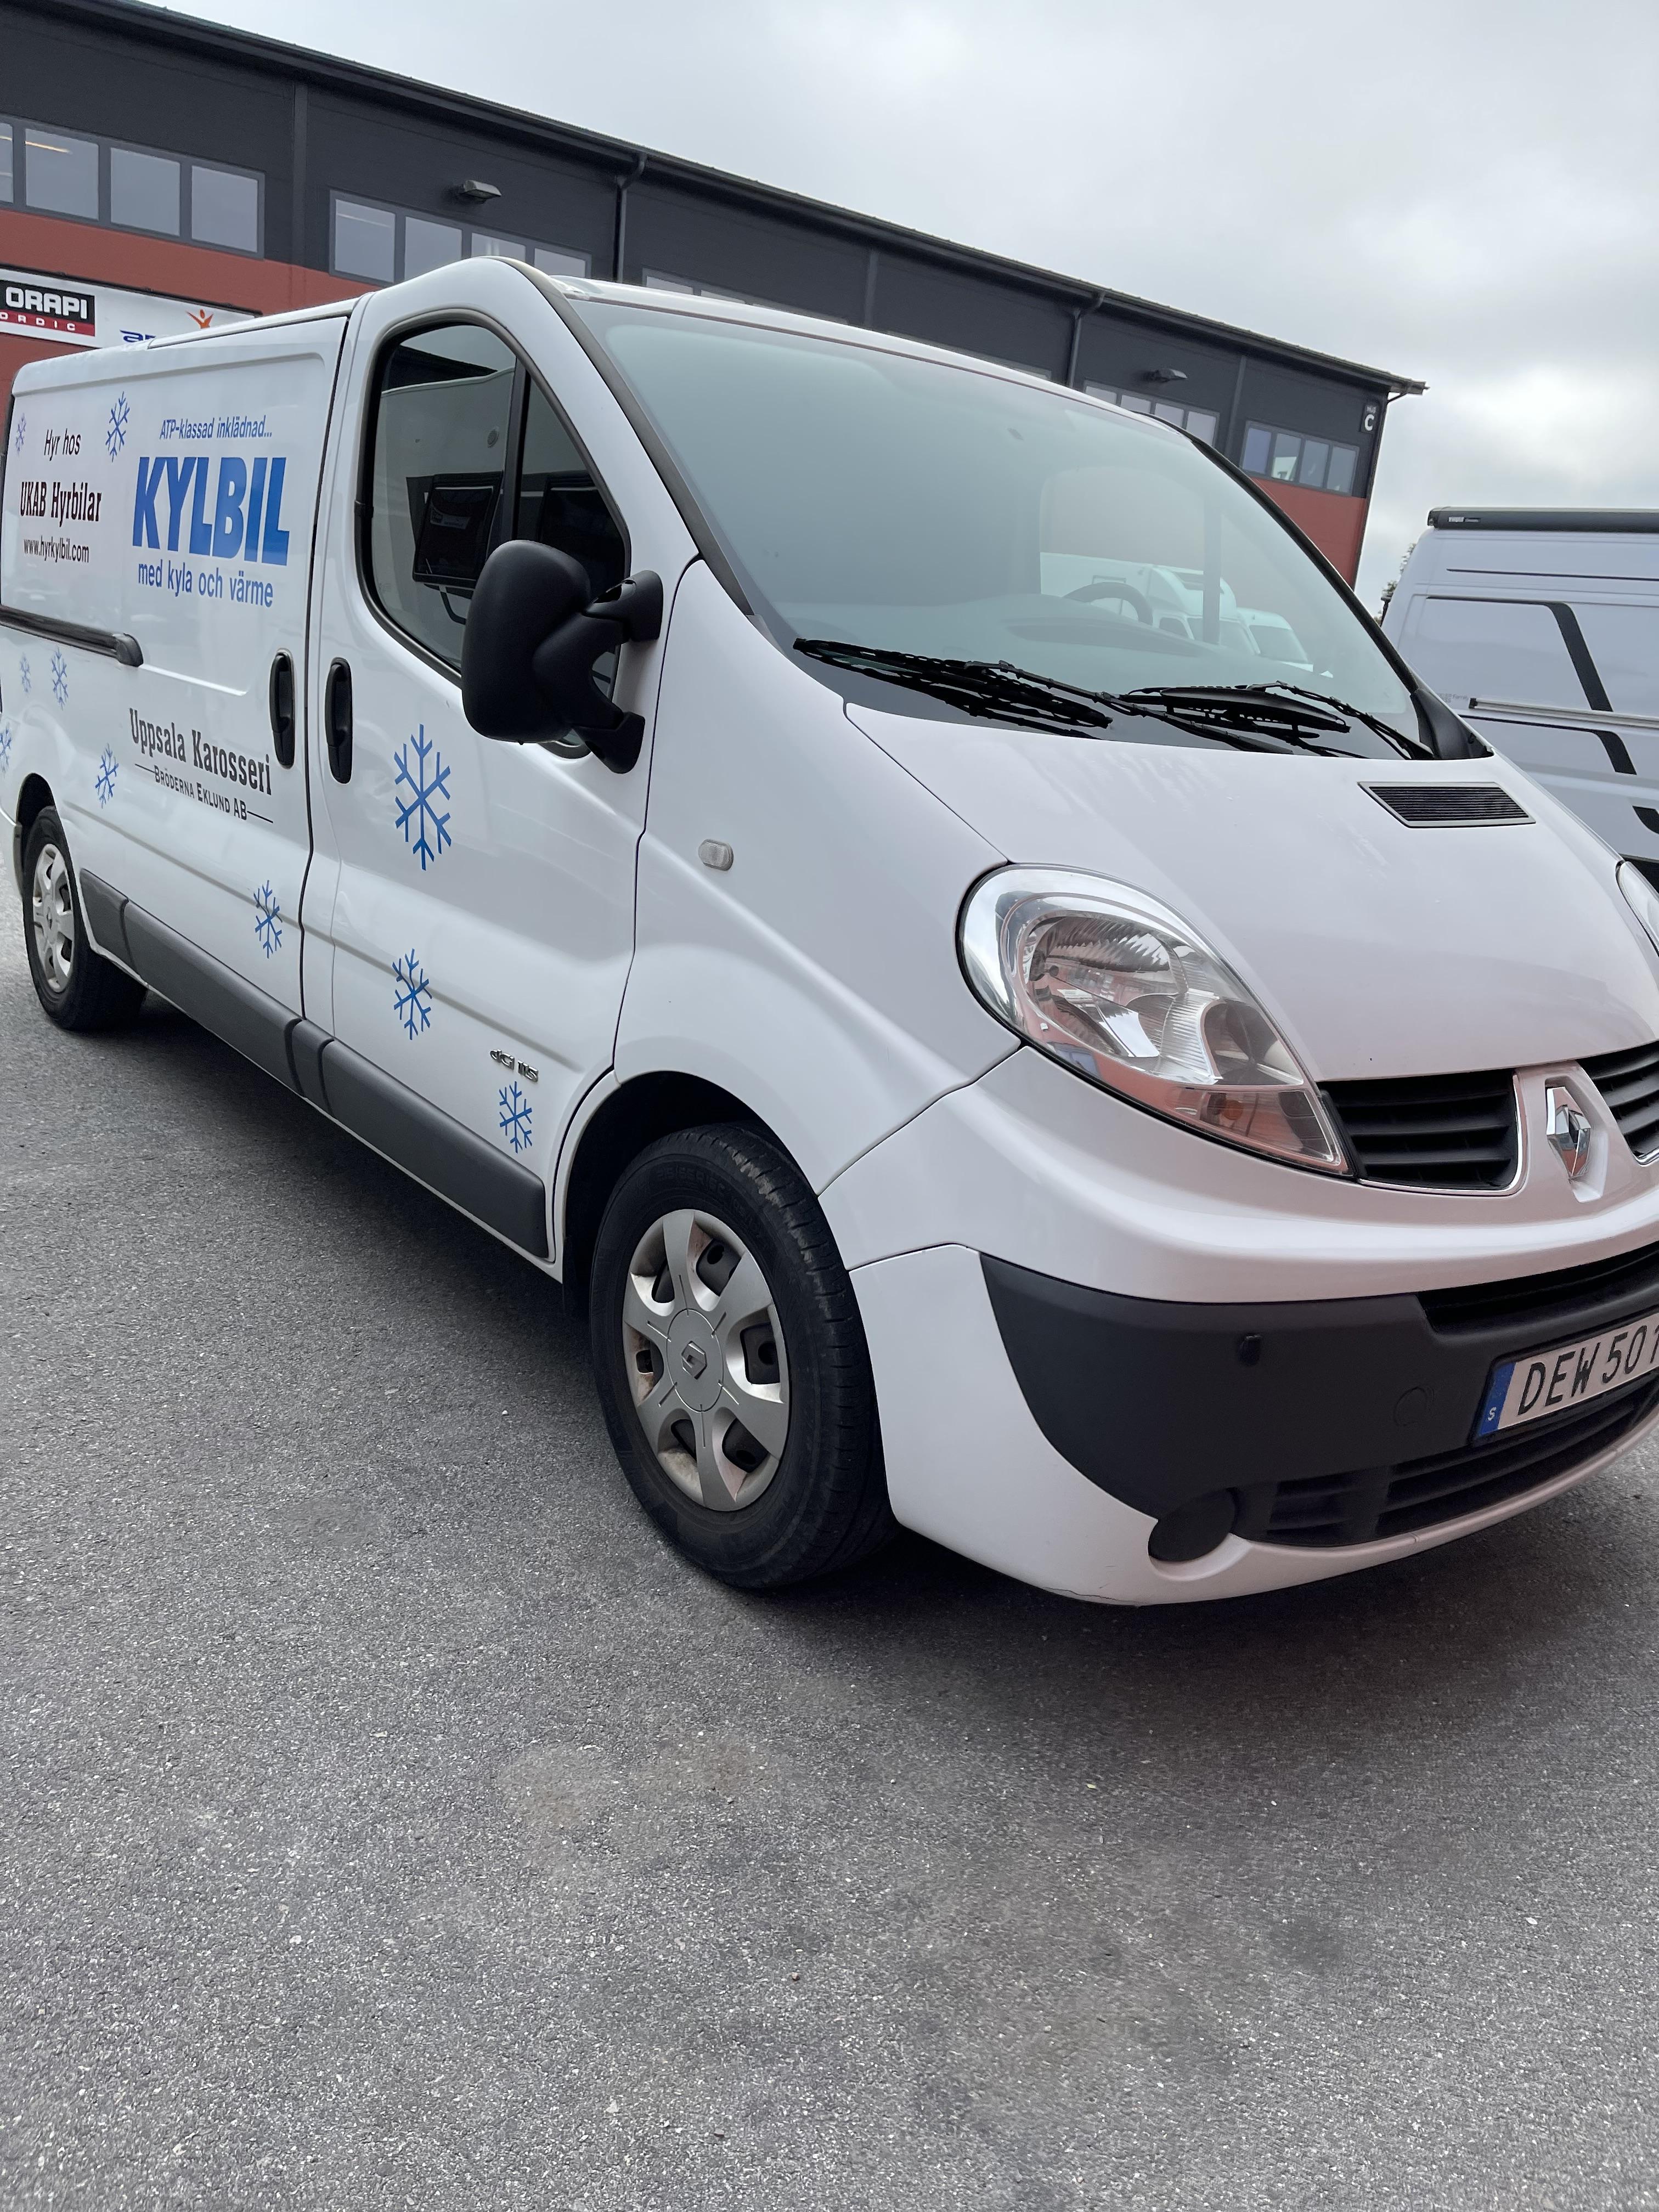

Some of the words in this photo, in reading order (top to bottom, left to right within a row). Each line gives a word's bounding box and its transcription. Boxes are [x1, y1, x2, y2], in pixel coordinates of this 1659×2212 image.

[5, 286, 87, 319] ORAPI
[160, 417, 215, 439] ATP-klassad
[1364, 414, 1375, 431] C
[43, 429, 61, 461] Hyr
[63, 428, 81, 455] hos
[20, 481, 47, 517] UKAB
[50, 481, 102, 528] Hyrbilar
[132, 456, 290, 566] KYLBIL
[24, 535, 89, 563] www.hyrkylbil.com
[138, 558, 163, 588] med
[167, 560, 192, 597] kyla
[198, 567, 223, 599] och
[229, 570, 274, 608] värme
[129, 707, 187, 763] Uppsala
[191, 729, 272, 795] Karosseri
[196, 782, 230, 814] EKLUND
[233, 798, 247, 820] AB
[1517, 1342, 1601, 1416] DEW
[1487, 1406, 1497, 1421] S
